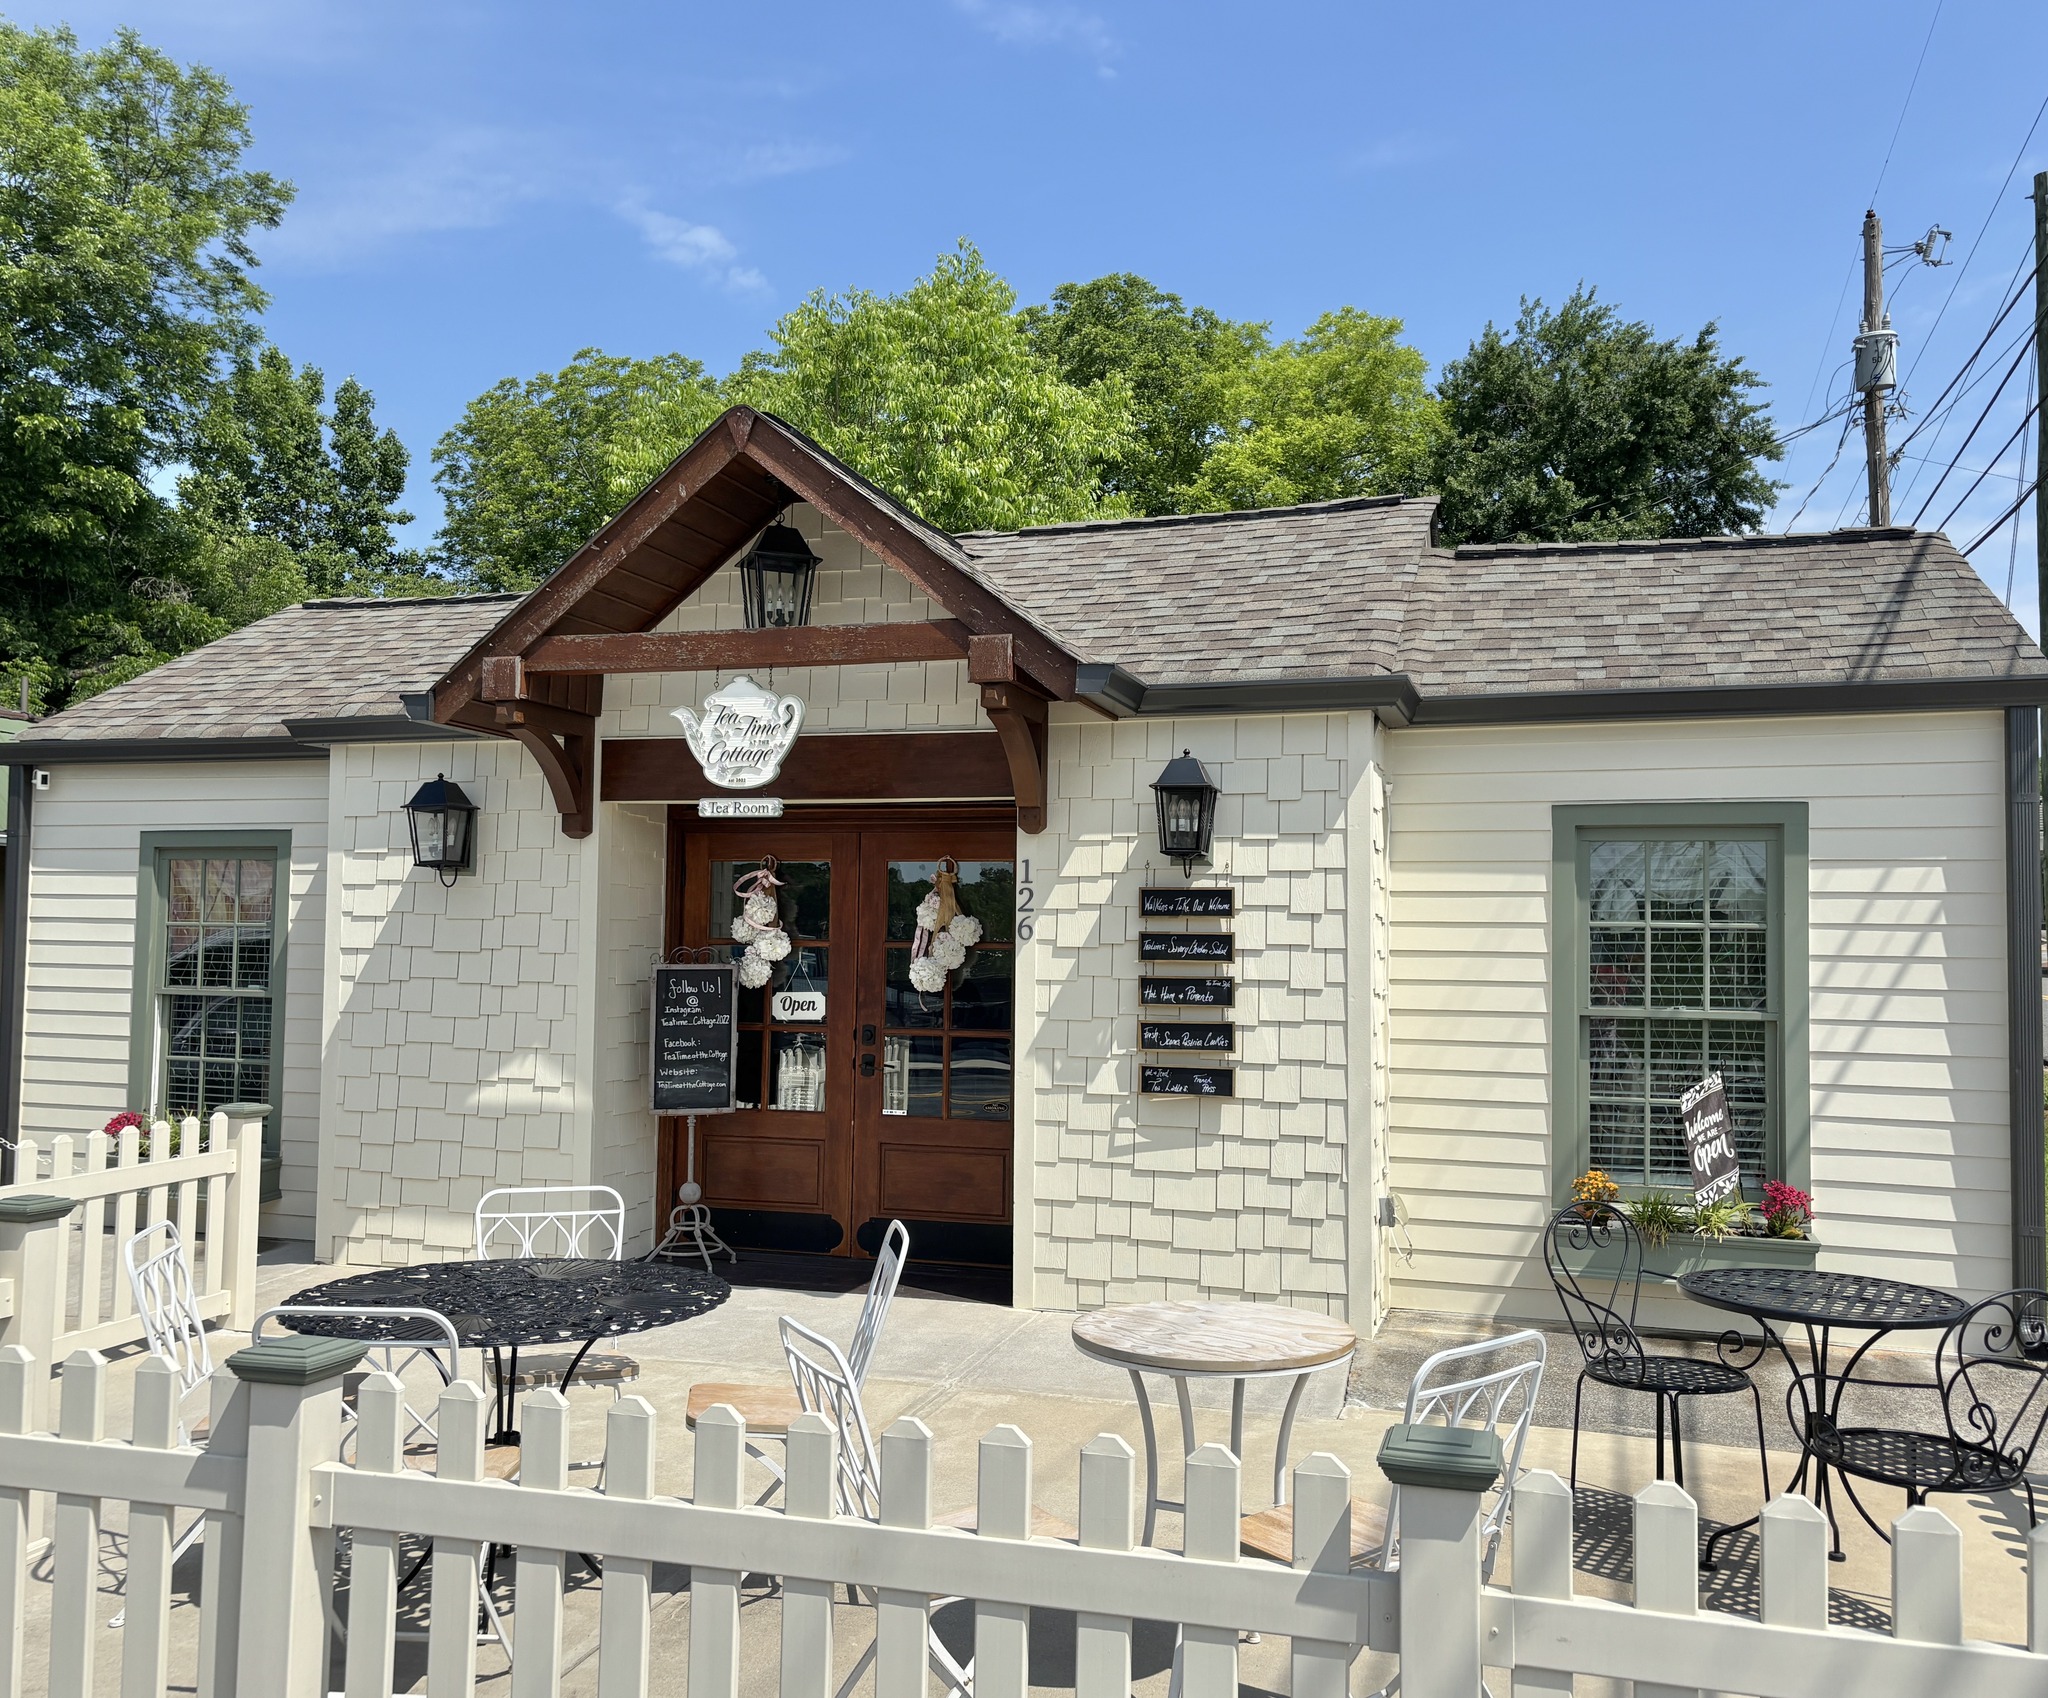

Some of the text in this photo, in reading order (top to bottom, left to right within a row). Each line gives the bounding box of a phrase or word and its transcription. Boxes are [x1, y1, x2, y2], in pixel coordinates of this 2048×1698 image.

[707, 741, 773, 767] Cottage
[709, 802, 769, 814] Tea Room
[1017, 859, 1034, 940] 126
[780, 996, 818, 1015] Open
[1685, 1108, 1724, 1141] Welcome
[1697, 1128, 1719, 1143] WE ARE
[1694, 1133, 1735, 1176] Open
